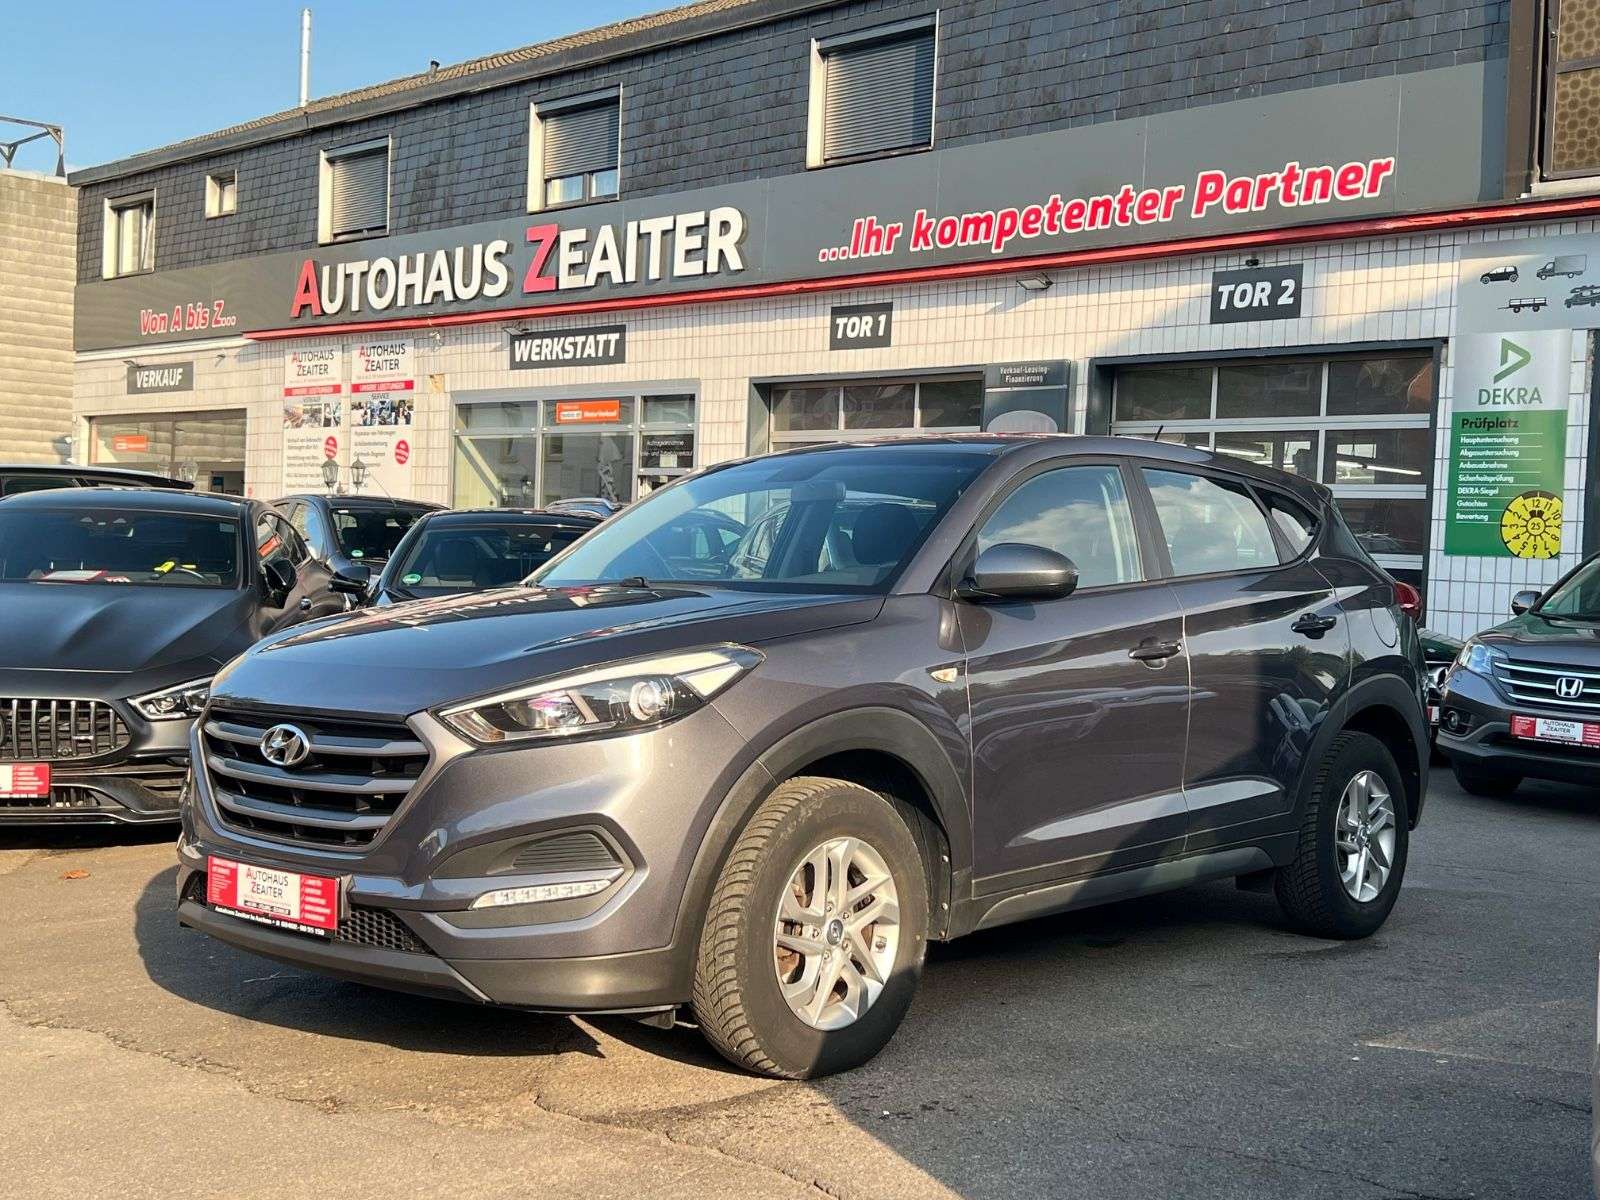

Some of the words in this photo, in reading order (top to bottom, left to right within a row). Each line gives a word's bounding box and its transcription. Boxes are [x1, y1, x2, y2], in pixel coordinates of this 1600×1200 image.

[817, 214, 903, 261] ...Ihr
[909, 184, 1181, 255] kompetenter
[1190, 156, 1395, 219] Partner
[289, 239, 508, 318] AUTOHAUS
[523, 206, 745, 294] ZEAITER
[1218, 281, 1271, 310] TOR
[1277, 279, 1295, 306] 2
[139, 308, 167, 335] Von
[170, 308, 182, 330] A
[185, 303, 209, 328] bis
[212, 300, 237, 328] Z...
[835, 316, 872, 339] TOR
[877, 314, 887, 337] 1
[359, 343, 406, 358] AUTOHAUS
[514, 333, 620, 362] WERKSTATT
[292, 350, 335, 362] AUTOHAUS
[297, 364, 329, 376] ZEAITER
[365, 359, 399, 372] ZEAITER
[136, 367, 182, 388] VERKAUF
[1478, 386, 1543, 406] DEKRA
[1461, 416, 1519, 431] Prüfplatz
[1460, 435, 1519, 444] Hauptuntersuchung
[1460, 448, 1519, 457] Abgasuntersuchung
[1459, 461, 1508, 469] Anbauabnahme
[1458, 474, 1514, 483] Sicherheitsprüfung
[1457, 487, 1499, 496] DEKRA-Siegel
[1532, 499, 1541, 508] 12
[1456, 512, 1488, 522] Bewertung
[246, 867, 289, 887] AUTOHAUS
[251, 881, 283, 898] ZEAITER
